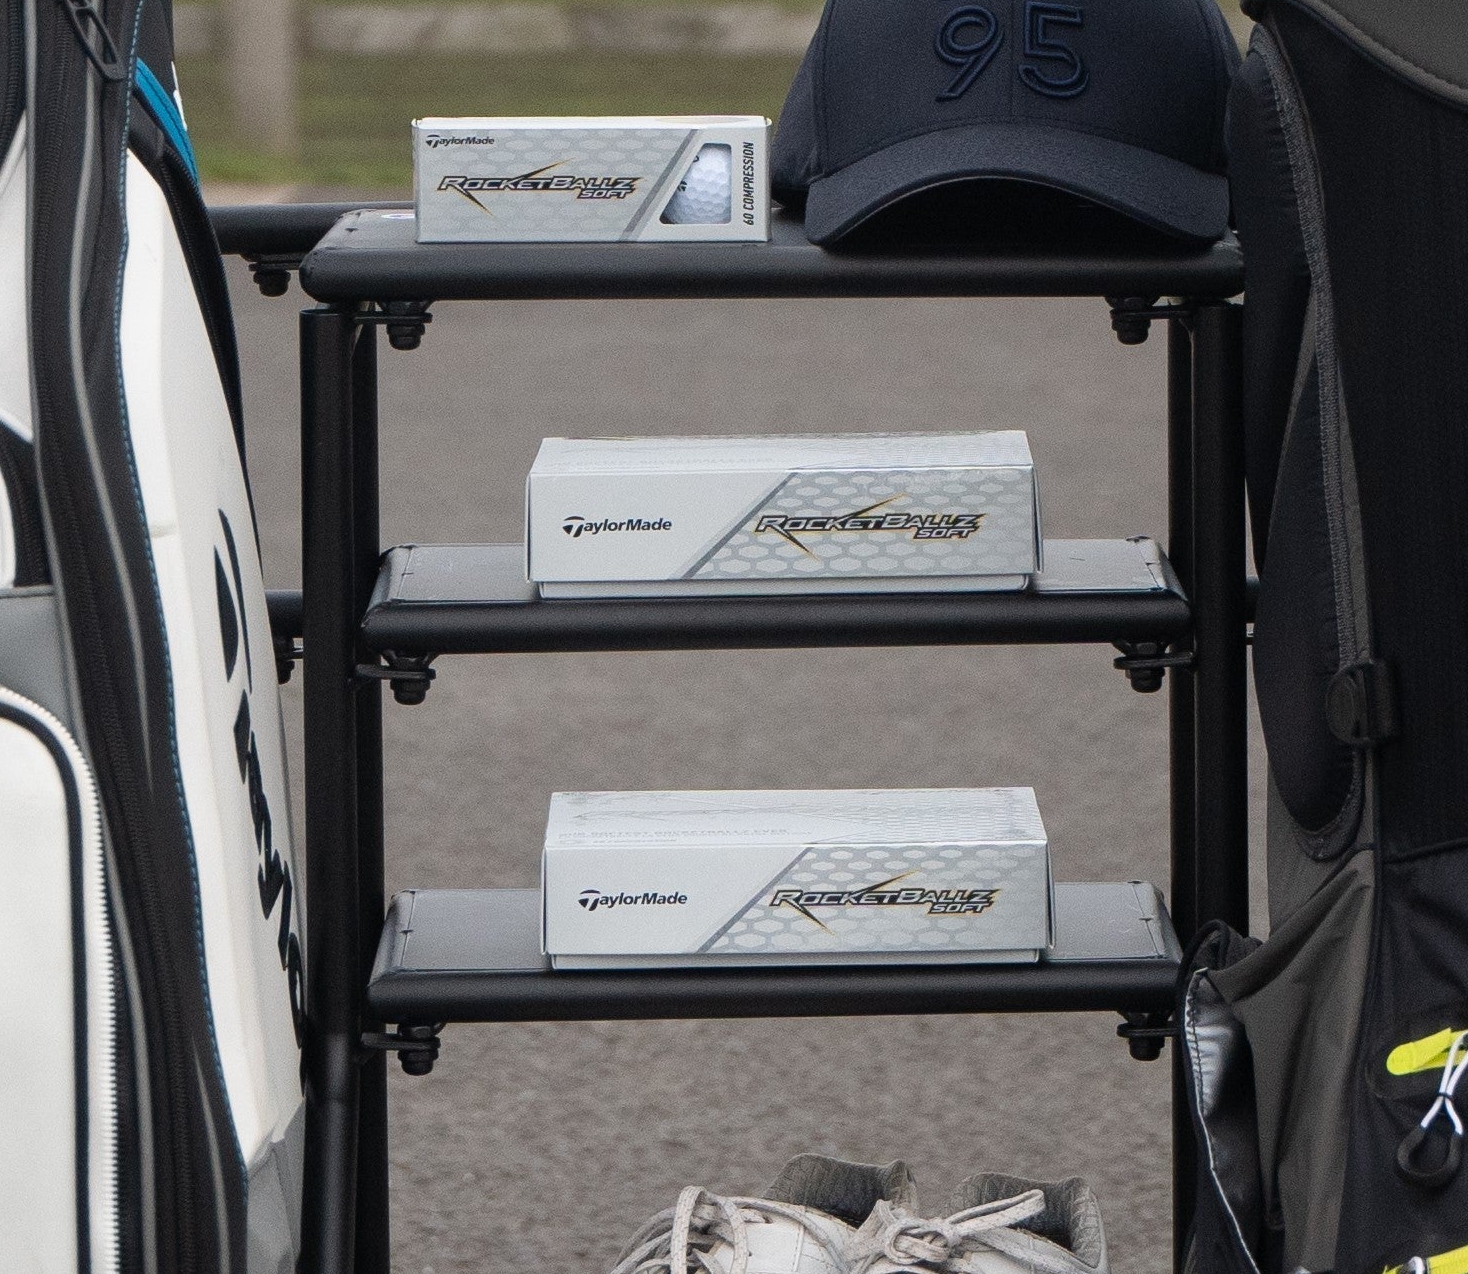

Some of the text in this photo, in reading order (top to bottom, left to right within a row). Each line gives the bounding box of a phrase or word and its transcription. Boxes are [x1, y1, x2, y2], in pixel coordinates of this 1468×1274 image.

[935, 1, 1090, 102] 95
[425, 134, 495, 149] TaylorMade
[742, 141, 754, 226] 60 COMPRESSION
[579, 189, 634, 200] SOFT
[562, 515, 672, 538] TaylorMade
[914, 528, 978, 540] SOFT
[578, 889, 688, 912] TaylorMade
[928, 903, 991, 914] SOFT
